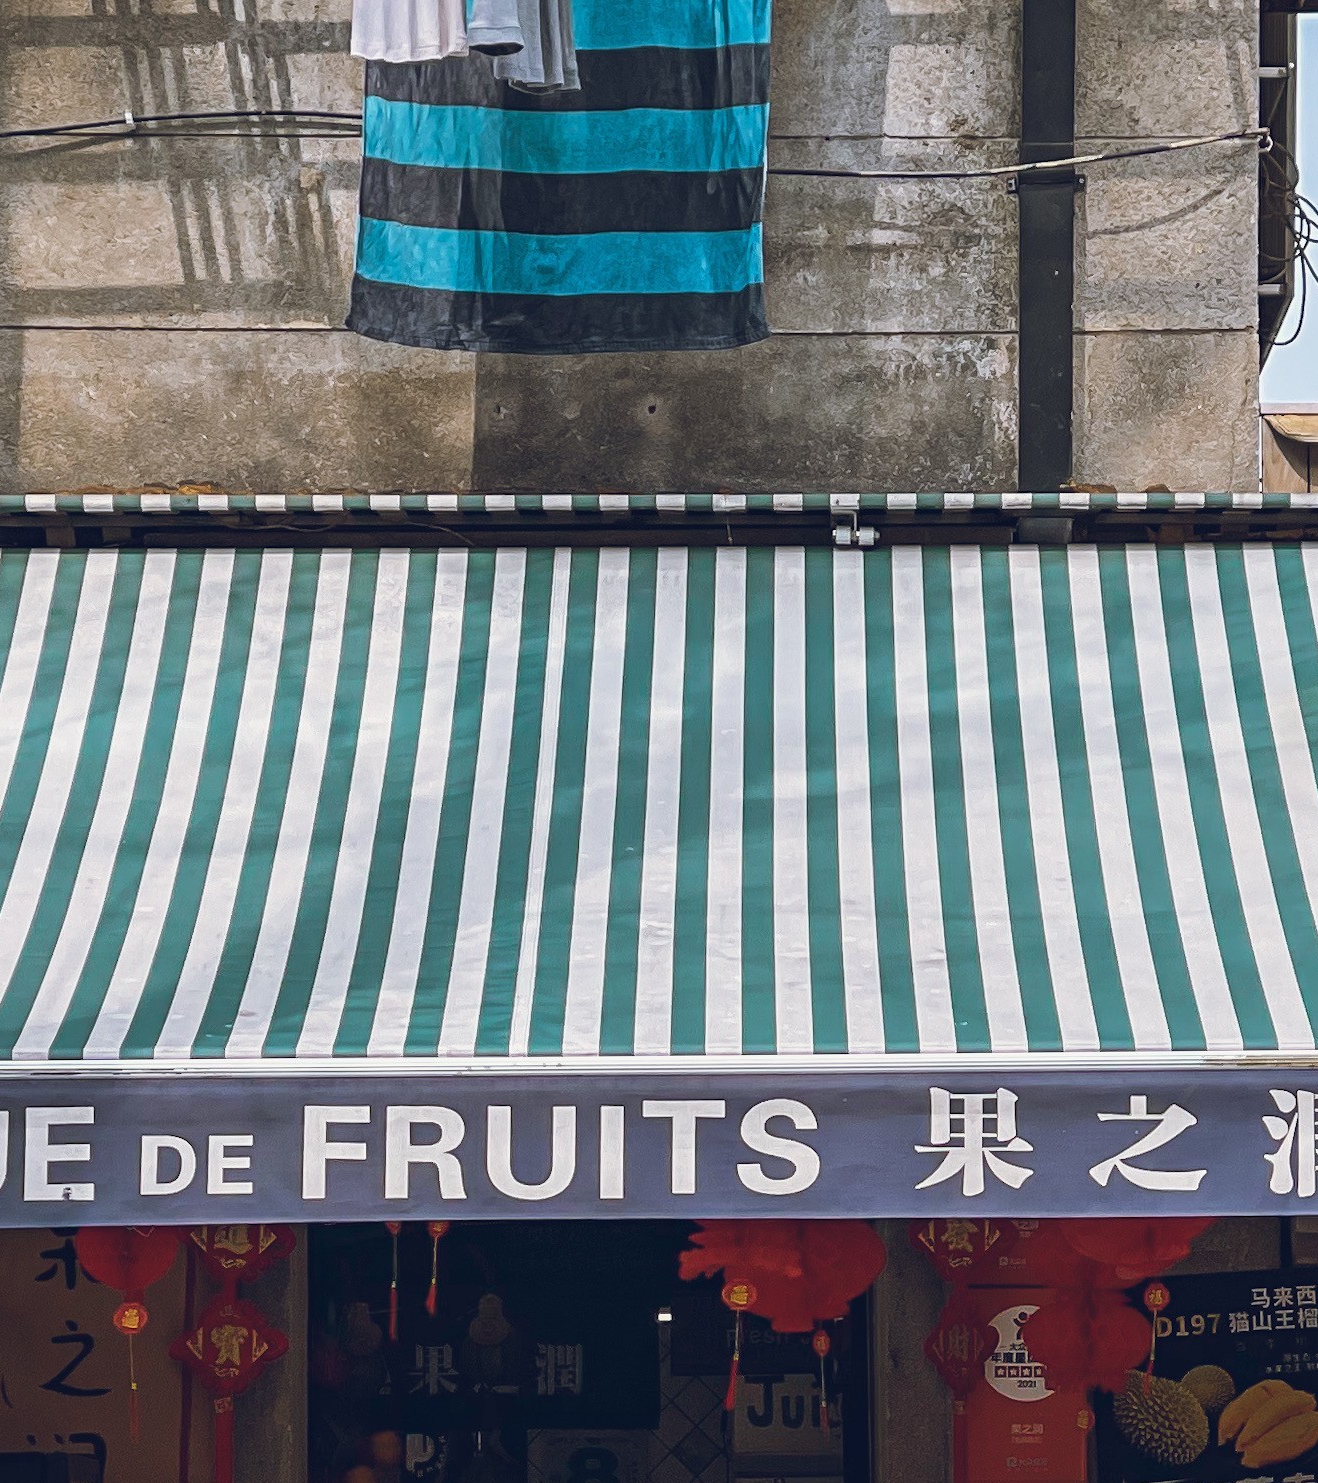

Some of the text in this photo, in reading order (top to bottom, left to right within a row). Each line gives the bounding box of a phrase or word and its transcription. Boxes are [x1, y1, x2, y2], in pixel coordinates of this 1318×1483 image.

[139, 1134, 254, 1196] DE
[301, 1098, 821, 1200] FRUITS
[1156, 1312, 1222, 1338] D197
